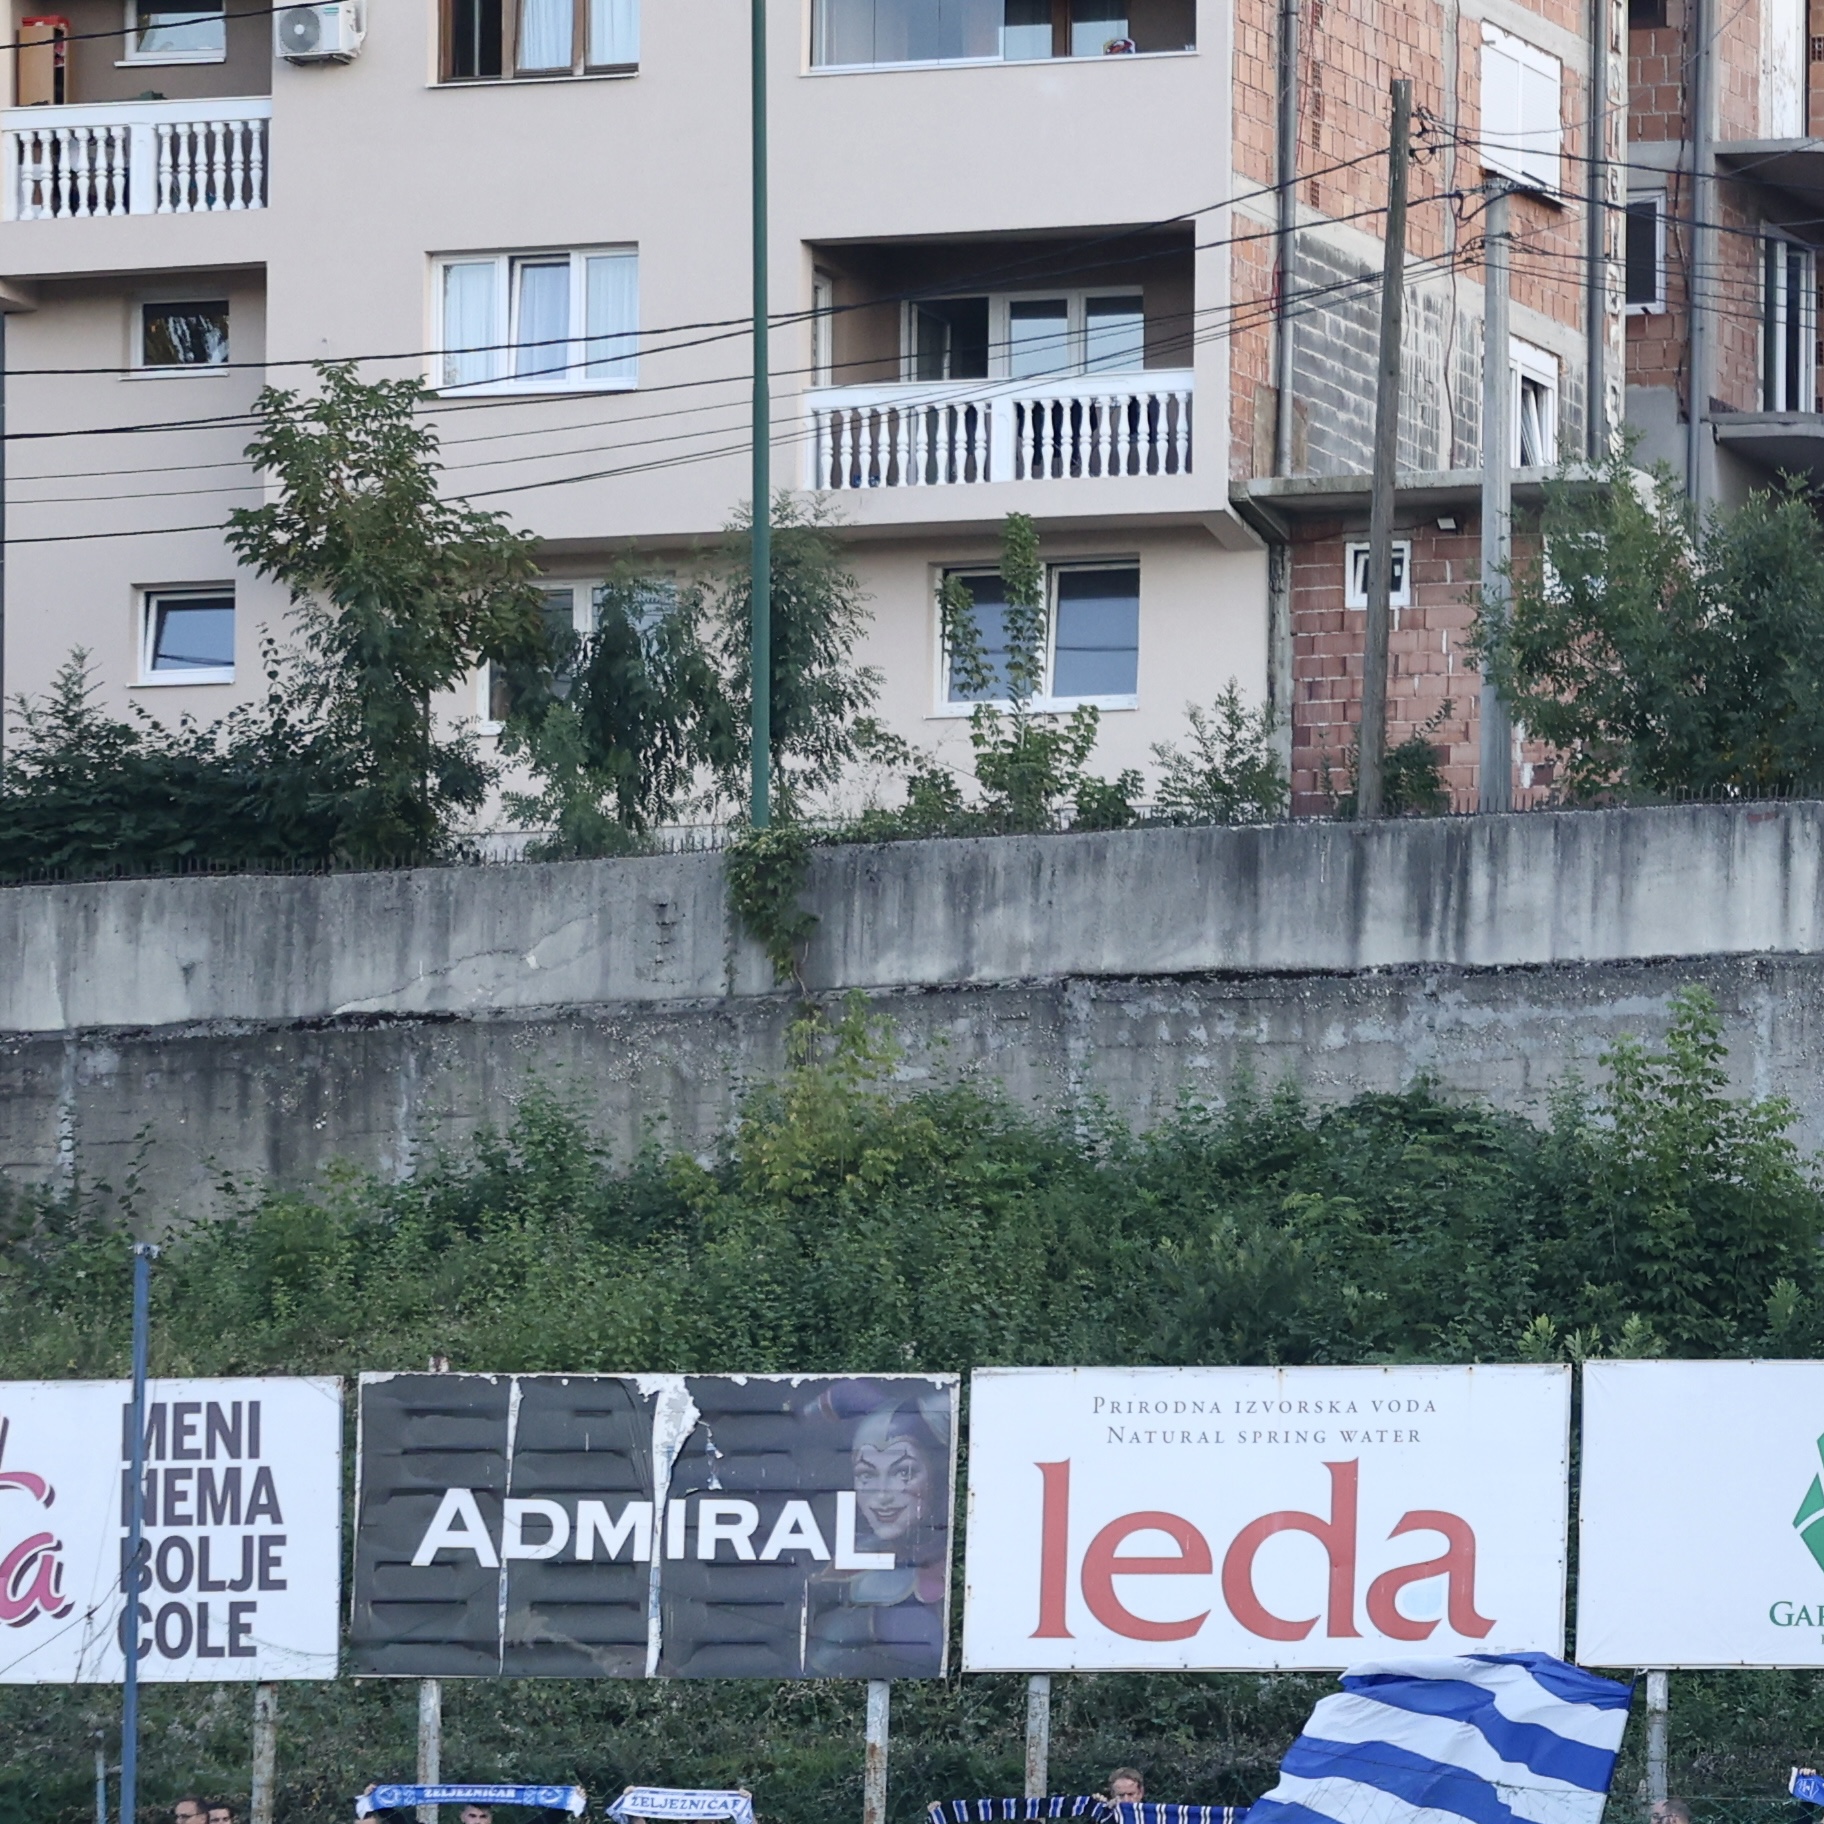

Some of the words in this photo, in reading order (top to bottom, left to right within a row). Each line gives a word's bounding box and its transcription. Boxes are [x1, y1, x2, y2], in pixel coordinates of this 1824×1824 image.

[121, 1400, 261, 1462] MENI
[1092, 1396, 1223, 1414] PRIRODNA
[1234, 1399, 1359, 1414] IZVORSKA
[1371, 1398, 1438, 1414] VODA
[1107, 1426, 1226, 1444] NATURAL
[1238, 1429, 1328, 1444] SPRING
[1339, 1429, 1422, 1443] WATER
[120, 1466, 284, 1527] NEMA
[411, 1487, 897, 1571] ADMIRAL
[1031, 1456, 1498, 1643] leda
[119, 1534, 288, 1594] BOLJE
[117, 1600, 258, 1661] COLE
